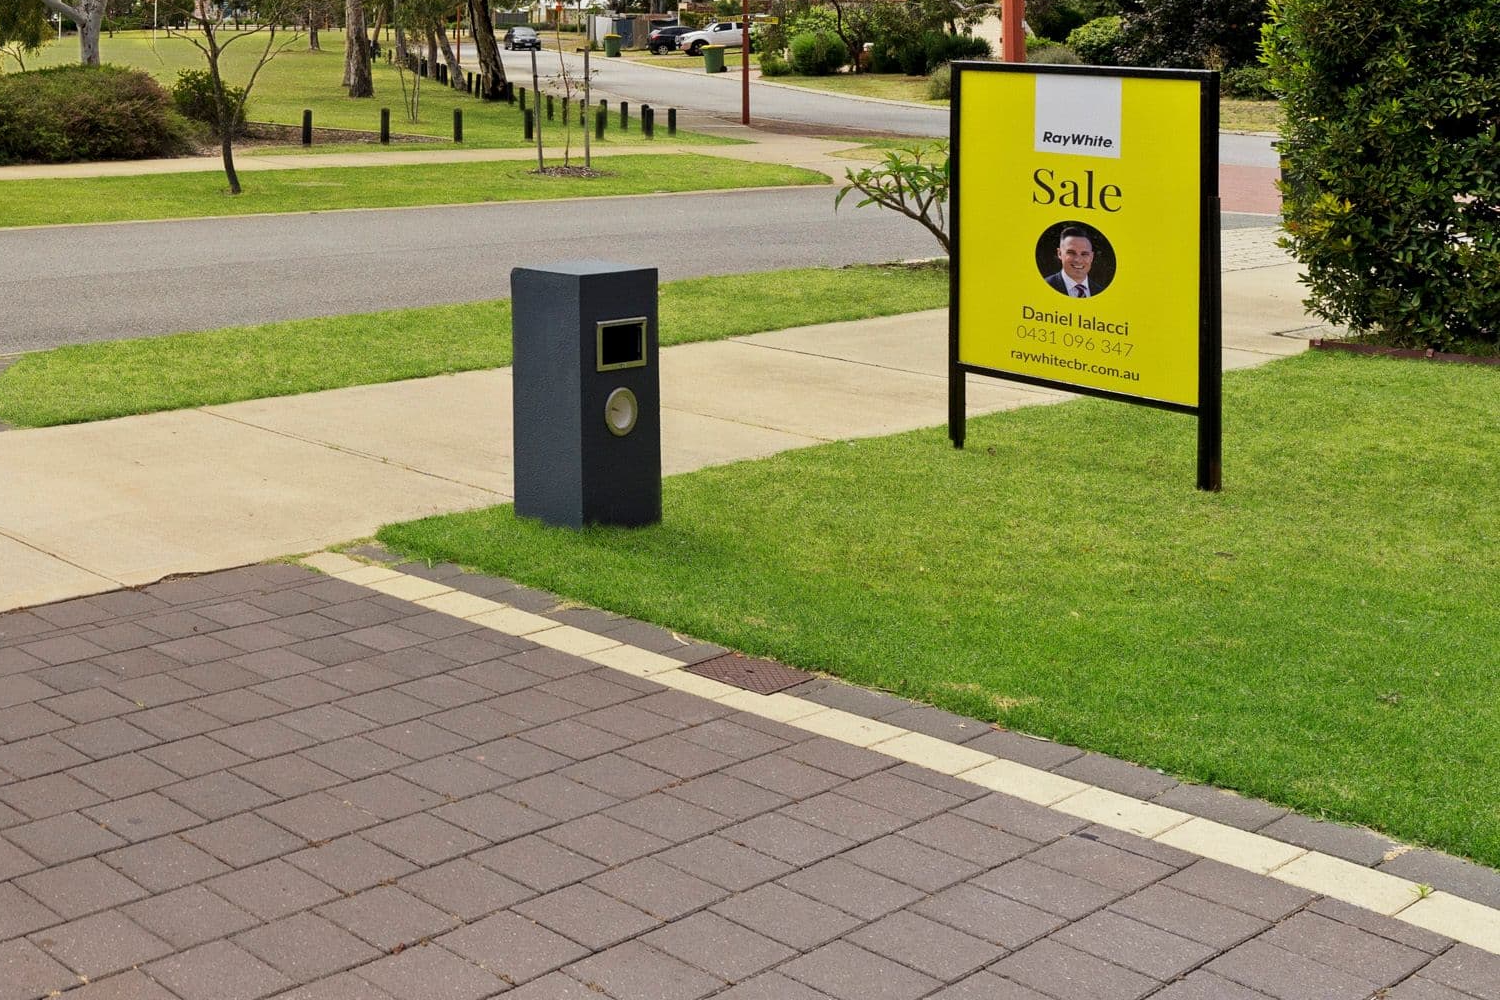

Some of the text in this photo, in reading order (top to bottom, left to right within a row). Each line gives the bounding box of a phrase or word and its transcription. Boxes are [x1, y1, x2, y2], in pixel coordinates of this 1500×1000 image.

[1032, 168, 1122, 212] Sale
[1022, 305, 1073, 327] Daniel
[1016, 325, 1134, 358] 0431 096 347
[1010, 349, 1140, 381] raywhitecbr.com.au
